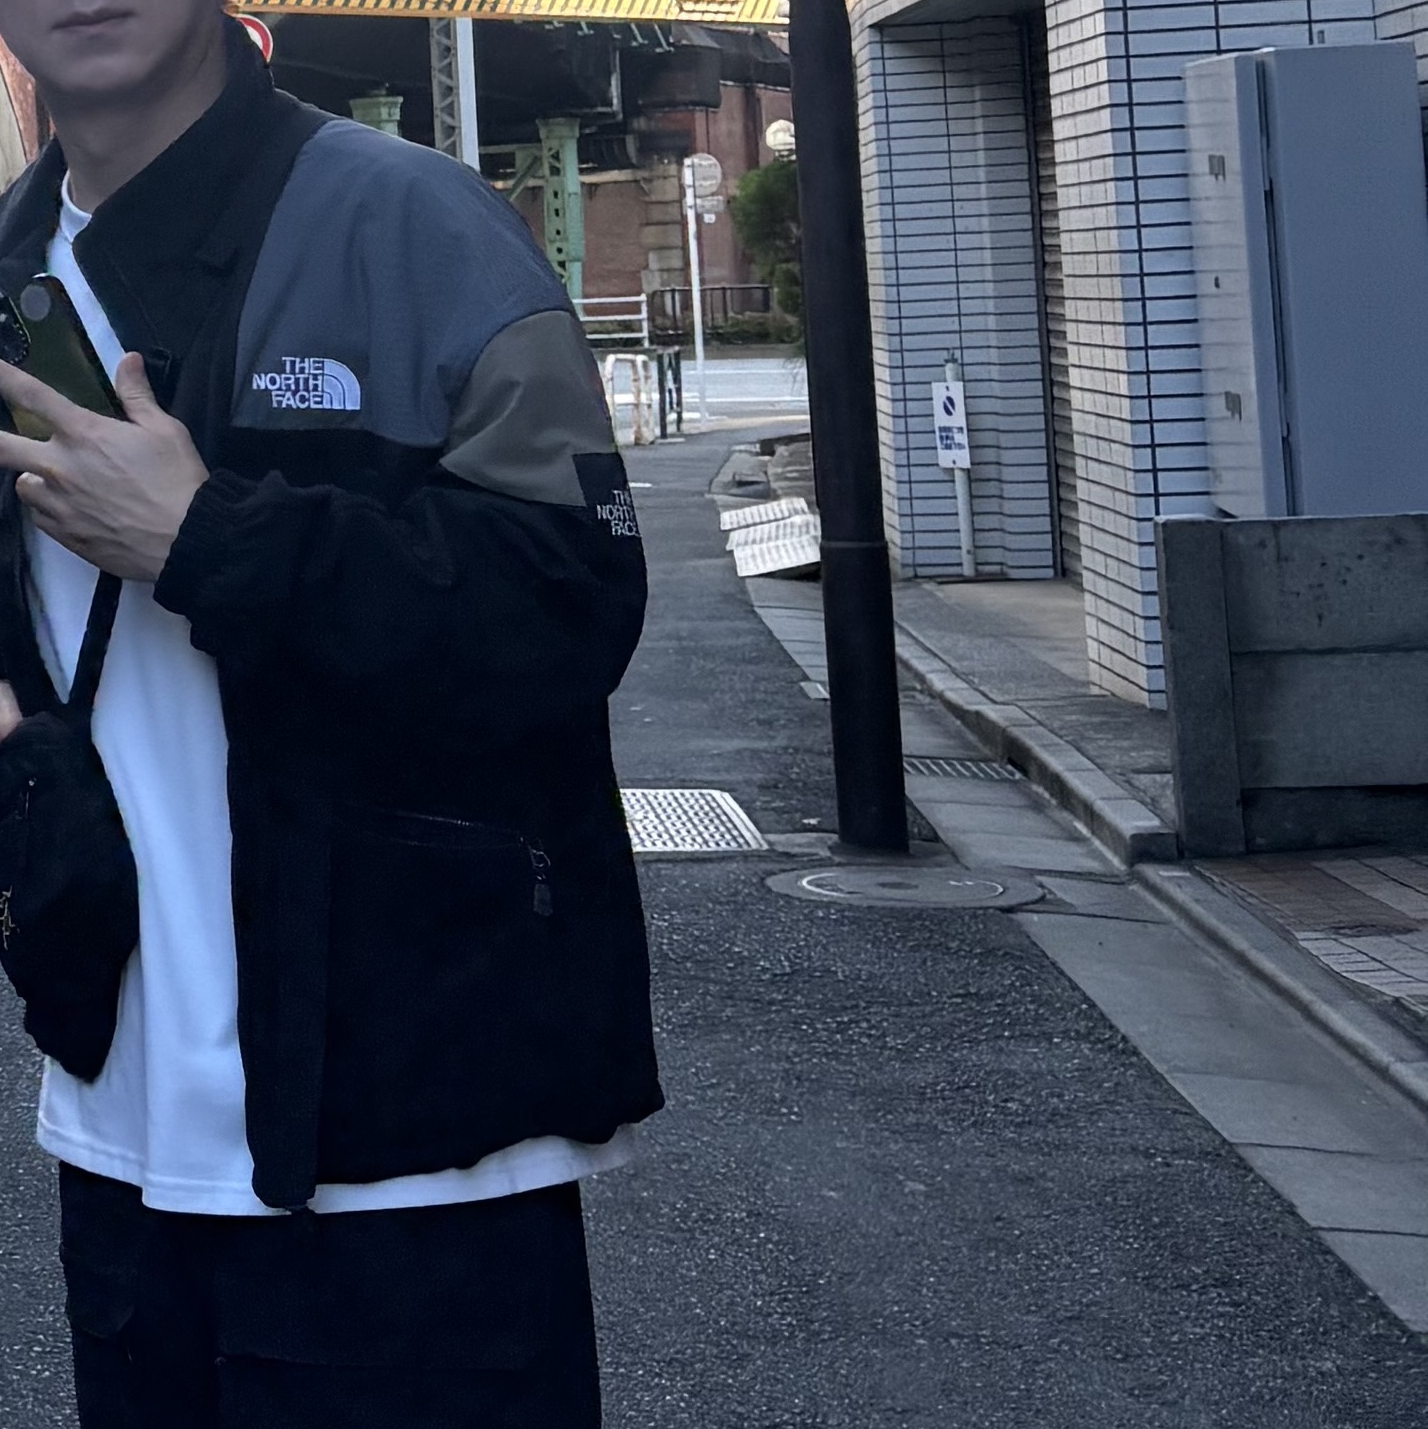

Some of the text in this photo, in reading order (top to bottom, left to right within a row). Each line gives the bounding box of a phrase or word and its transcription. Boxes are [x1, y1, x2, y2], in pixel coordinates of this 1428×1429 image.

[282, 357, 323, 373] THE
[252, 373, 323, 391] NORTH
[272, 391, 324, 409] FACE
